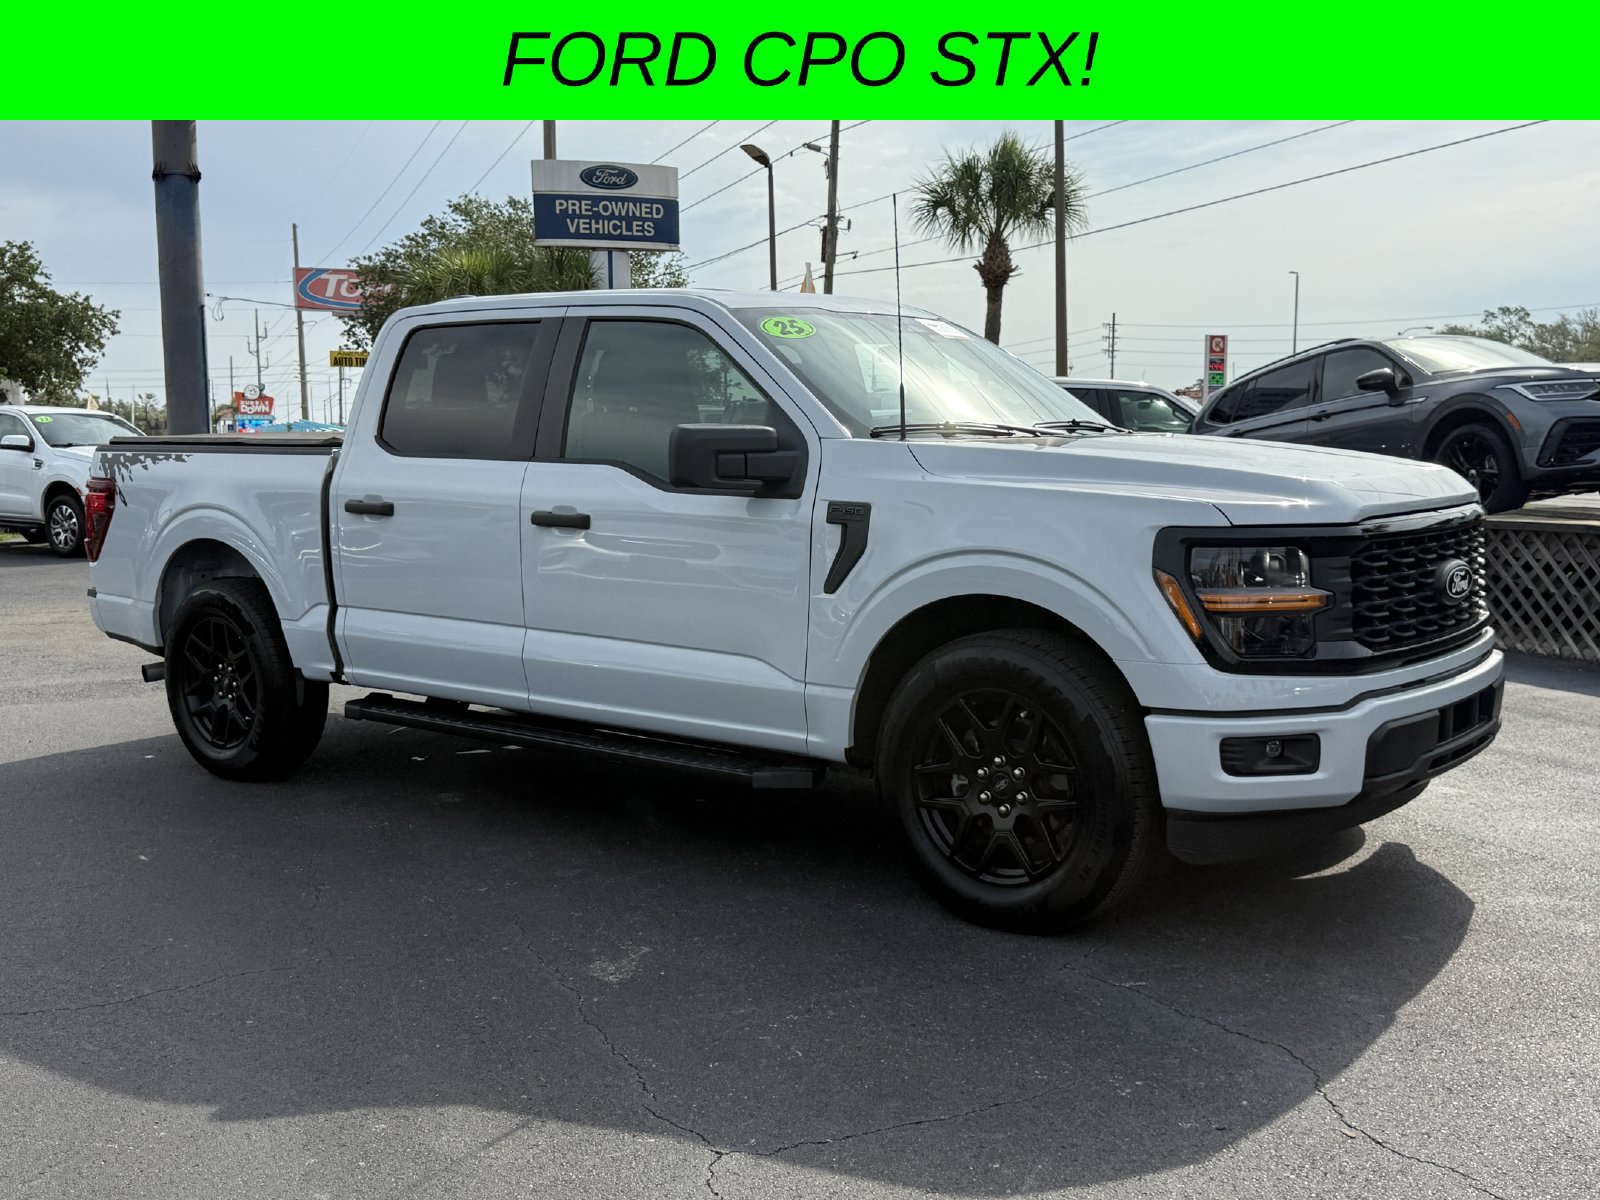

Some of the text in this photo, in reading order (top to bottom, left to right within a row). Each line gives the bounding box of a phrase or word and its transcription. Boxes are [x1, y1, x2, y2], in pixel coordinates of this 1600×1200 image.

[592, 168, 627, 185] Ford
[555, 199, 664, 219] PRE-OWNED
[566, 218, 655, 237] VEHICLES
[773, 319, 805, 336] 25
[333, 356, 353, 367] AUTO
[240, 404, 270, 414] DOWN
[1452, 571, 1469, 593] Ford
